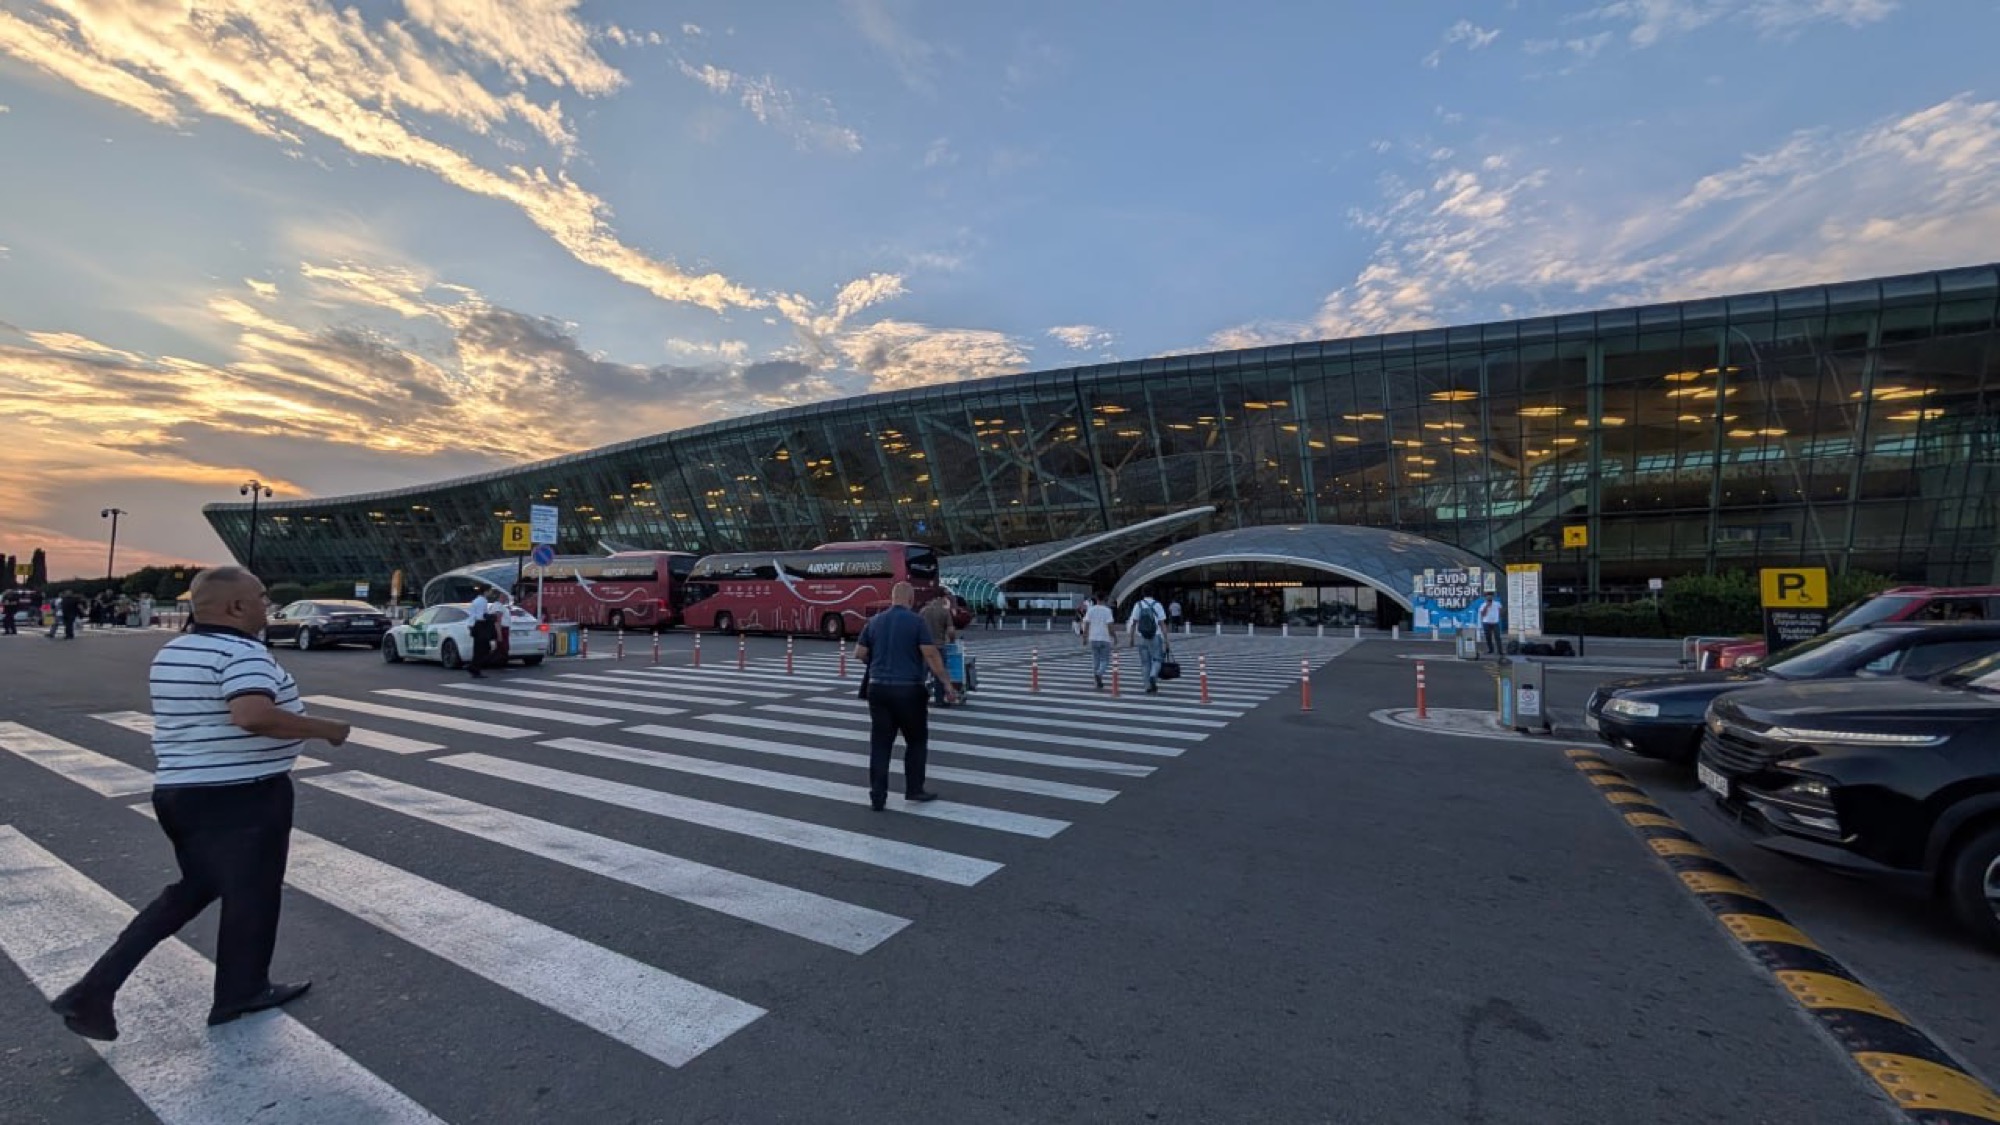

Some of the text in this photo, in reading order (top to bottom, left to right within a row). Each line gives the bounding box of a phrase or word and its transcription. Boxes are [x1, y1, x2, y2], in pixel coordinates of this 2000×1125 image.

[512, 527, 523, 541] B
[807, 561, 883, 573] AIRPORT EXPRESS
[1437, 574, 1467, 584] EVDƏ
[1777, 573, 1805, 600] P
[1437, 598, 1467, 608] BAKI
